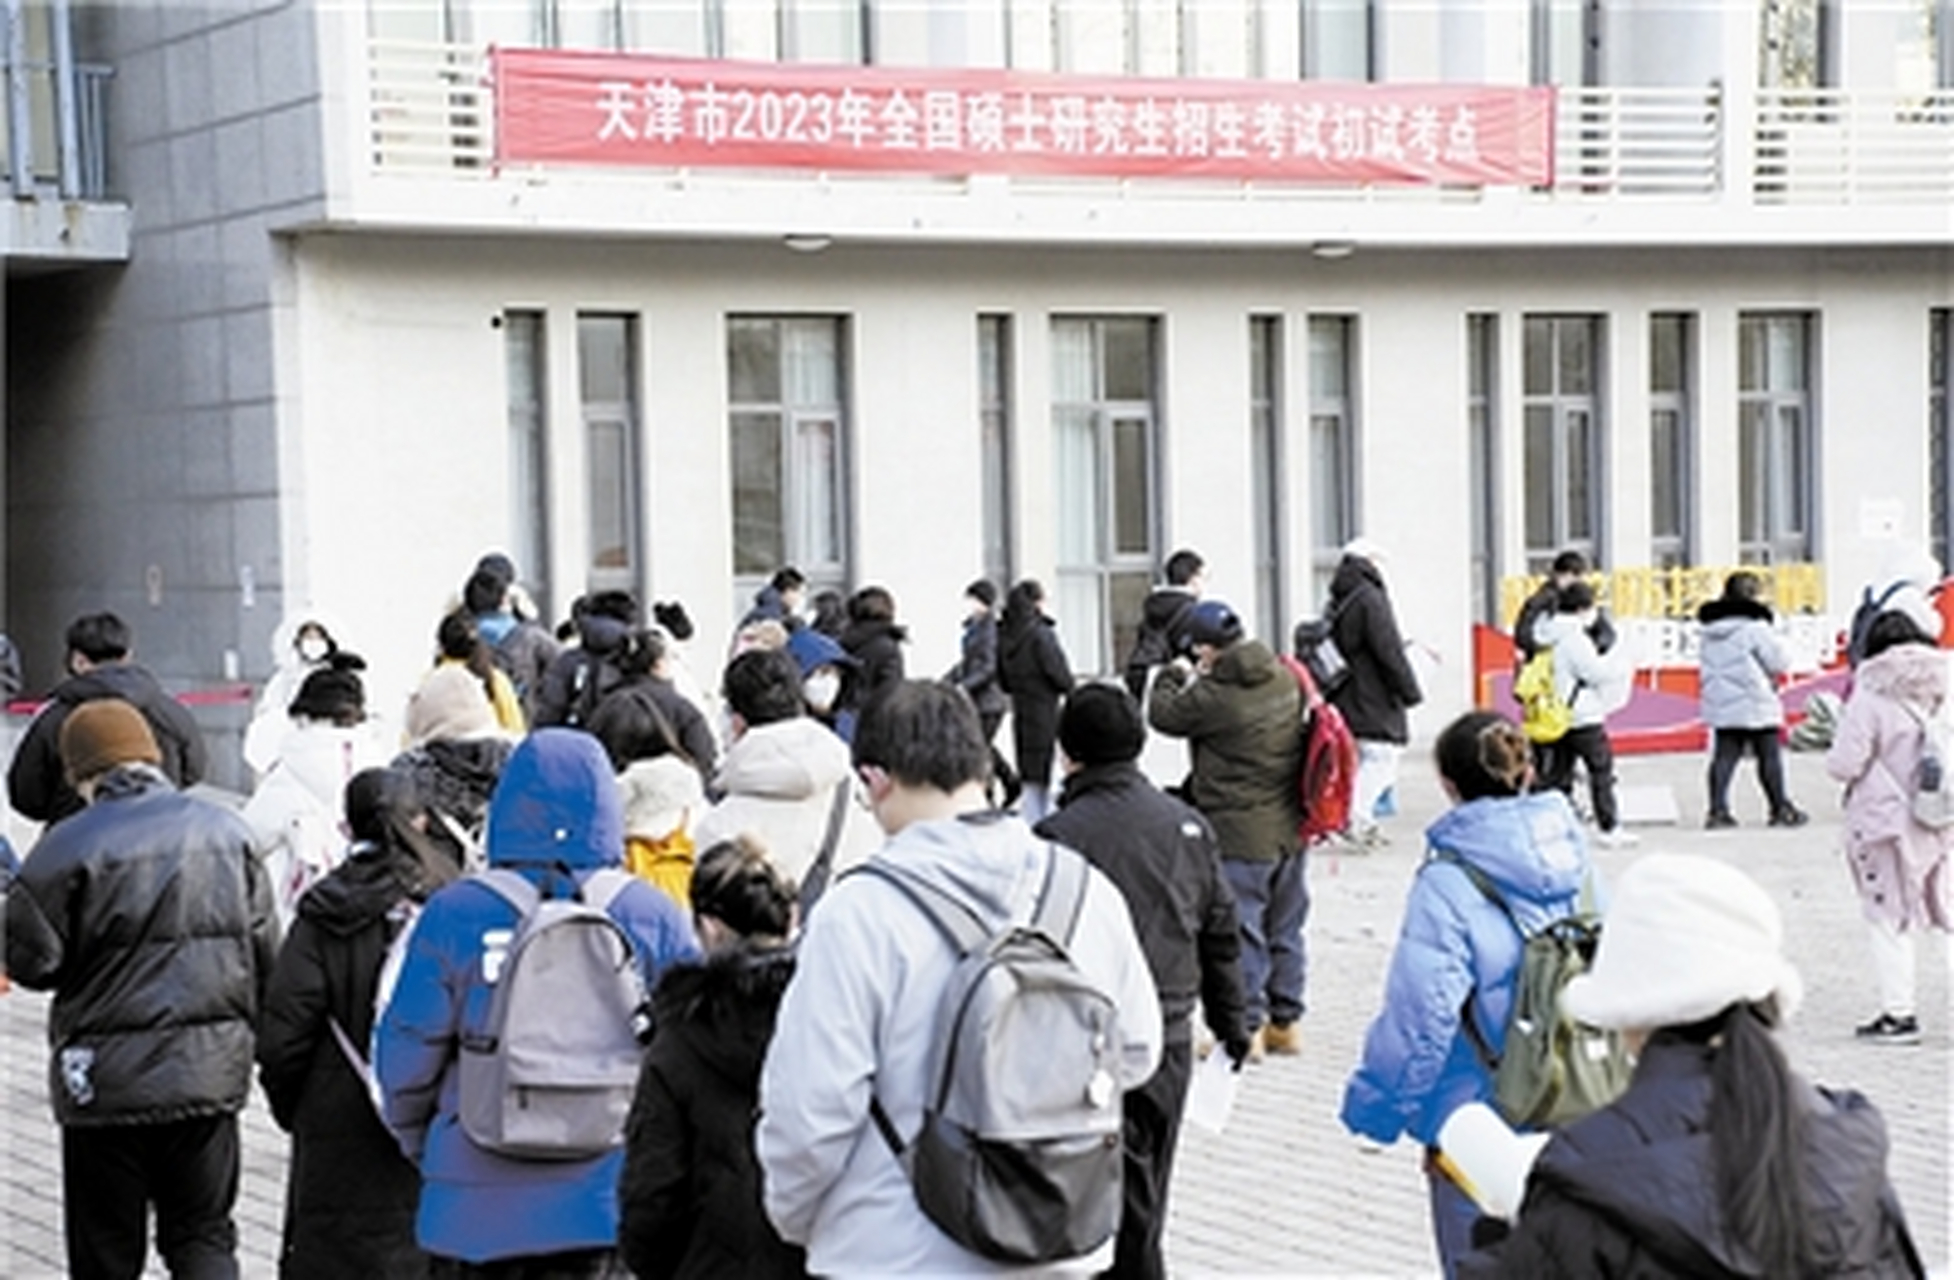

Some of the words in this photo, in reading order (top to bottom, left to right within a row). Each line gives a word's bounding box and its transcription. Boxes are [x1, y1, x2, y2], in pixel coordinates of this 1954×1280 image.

[595, 79, 1479, 162] 天津市2023年全国硕士研究生招生考试初试考点
